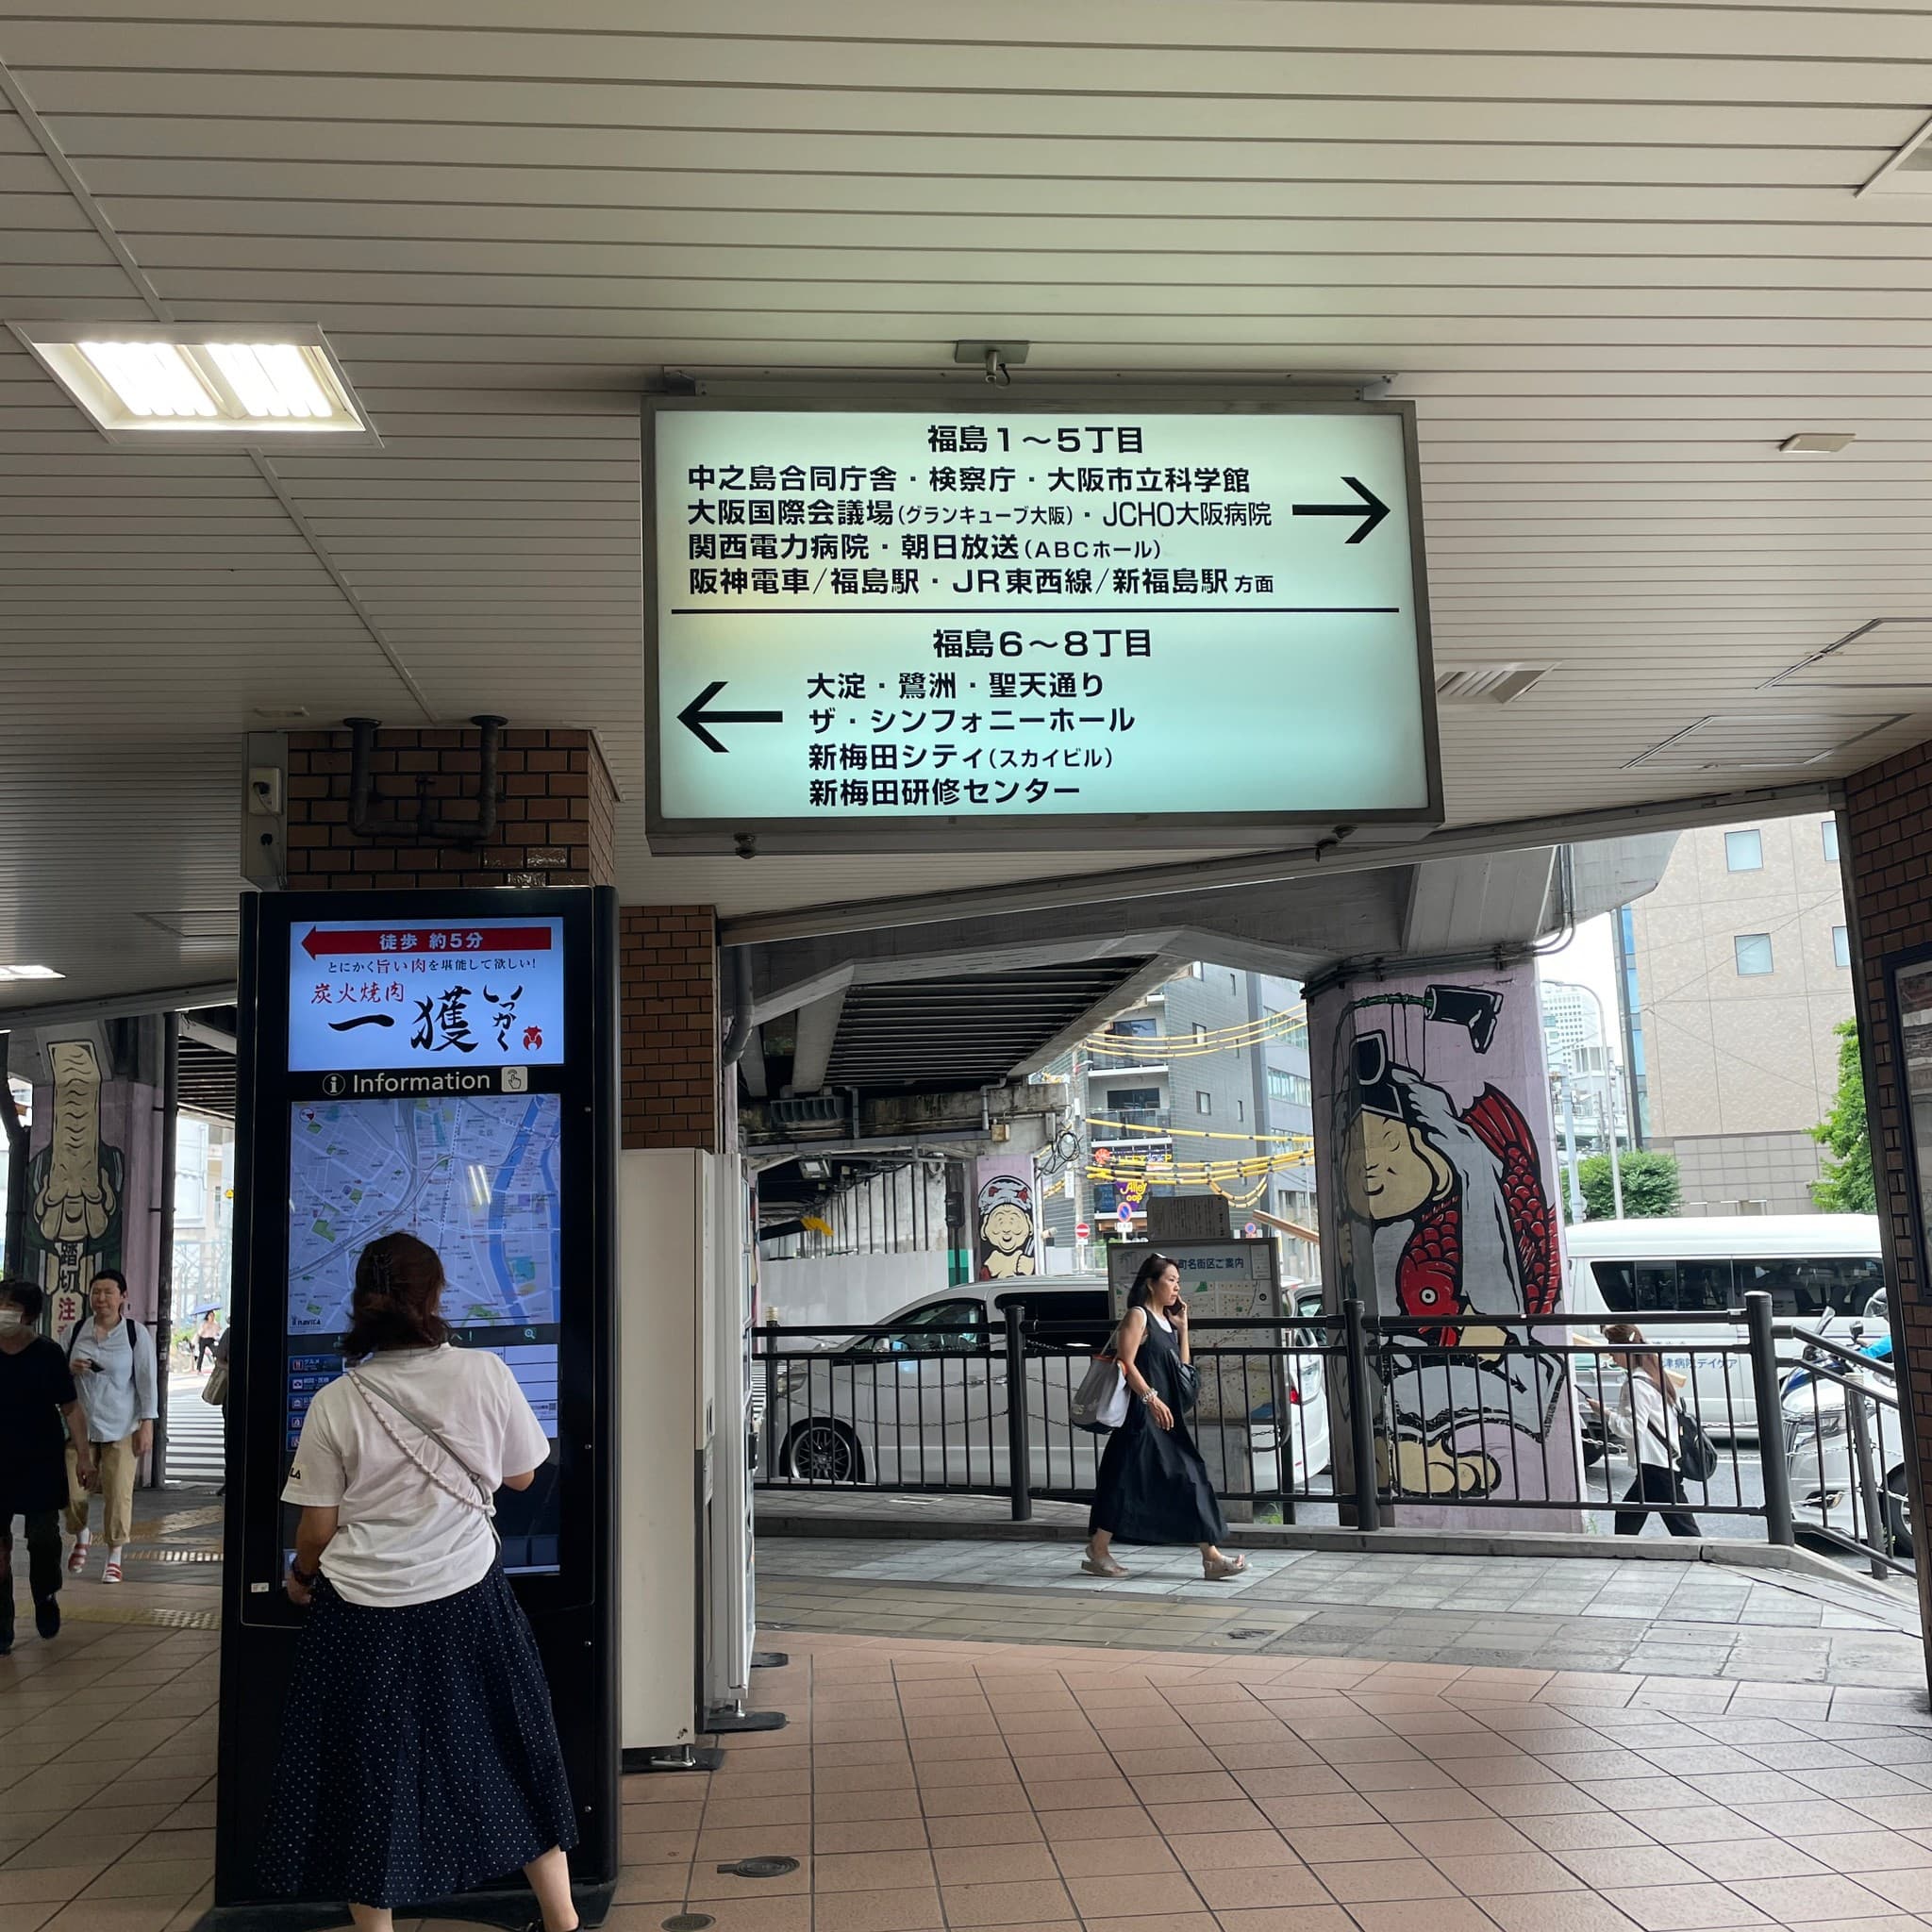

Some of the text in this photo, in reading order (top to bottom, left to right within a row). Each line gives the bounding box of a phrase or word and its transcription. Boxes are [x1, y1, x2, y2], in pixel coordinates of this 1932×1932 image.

[808, 707, 1136, 734] ザ・シンフォニーホール
[808, 777, 1081, 807] 新梅田研修センター
[379, 932, 484, 950] 徒歩 約5分
[310, 981, 405, 1005] 炭火焼肉
[352, 1071, 491, 1094] Information
[58, 1242, 78, 1336] 踏切注
